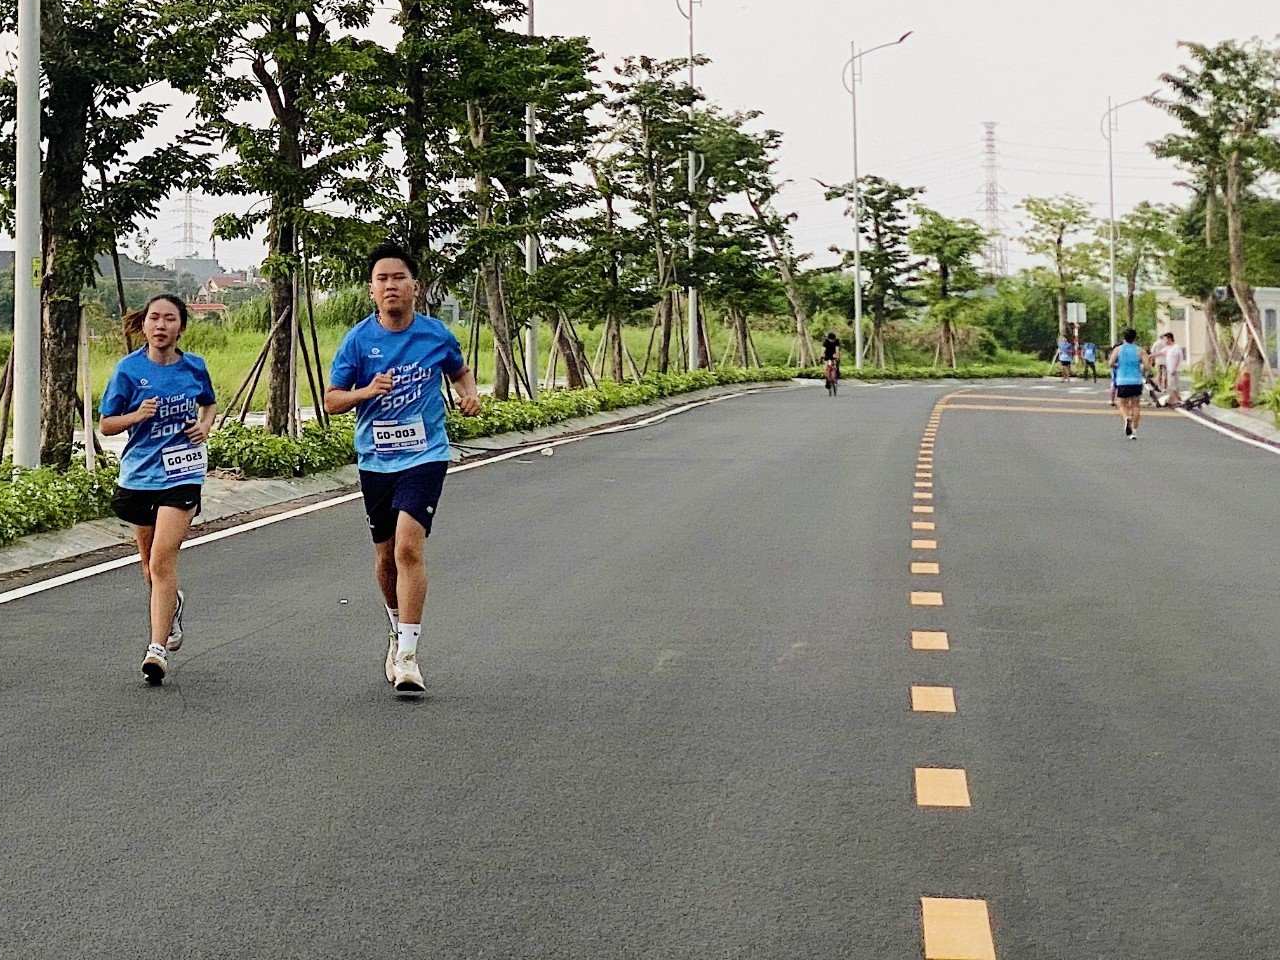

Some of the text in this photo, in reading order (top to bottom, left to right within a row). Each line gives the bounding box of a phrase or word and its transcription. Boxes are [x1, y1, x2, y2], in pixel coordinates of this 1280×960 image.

[397, 361, 419, 373] Your
[165, 393, 186, 404] Your
[381, 384, 422, 411] Soul
[160, 397, 197, 418] Body
[376, 428, 416, 440] GO-003
[168, 452, 202, 465] GO-025
